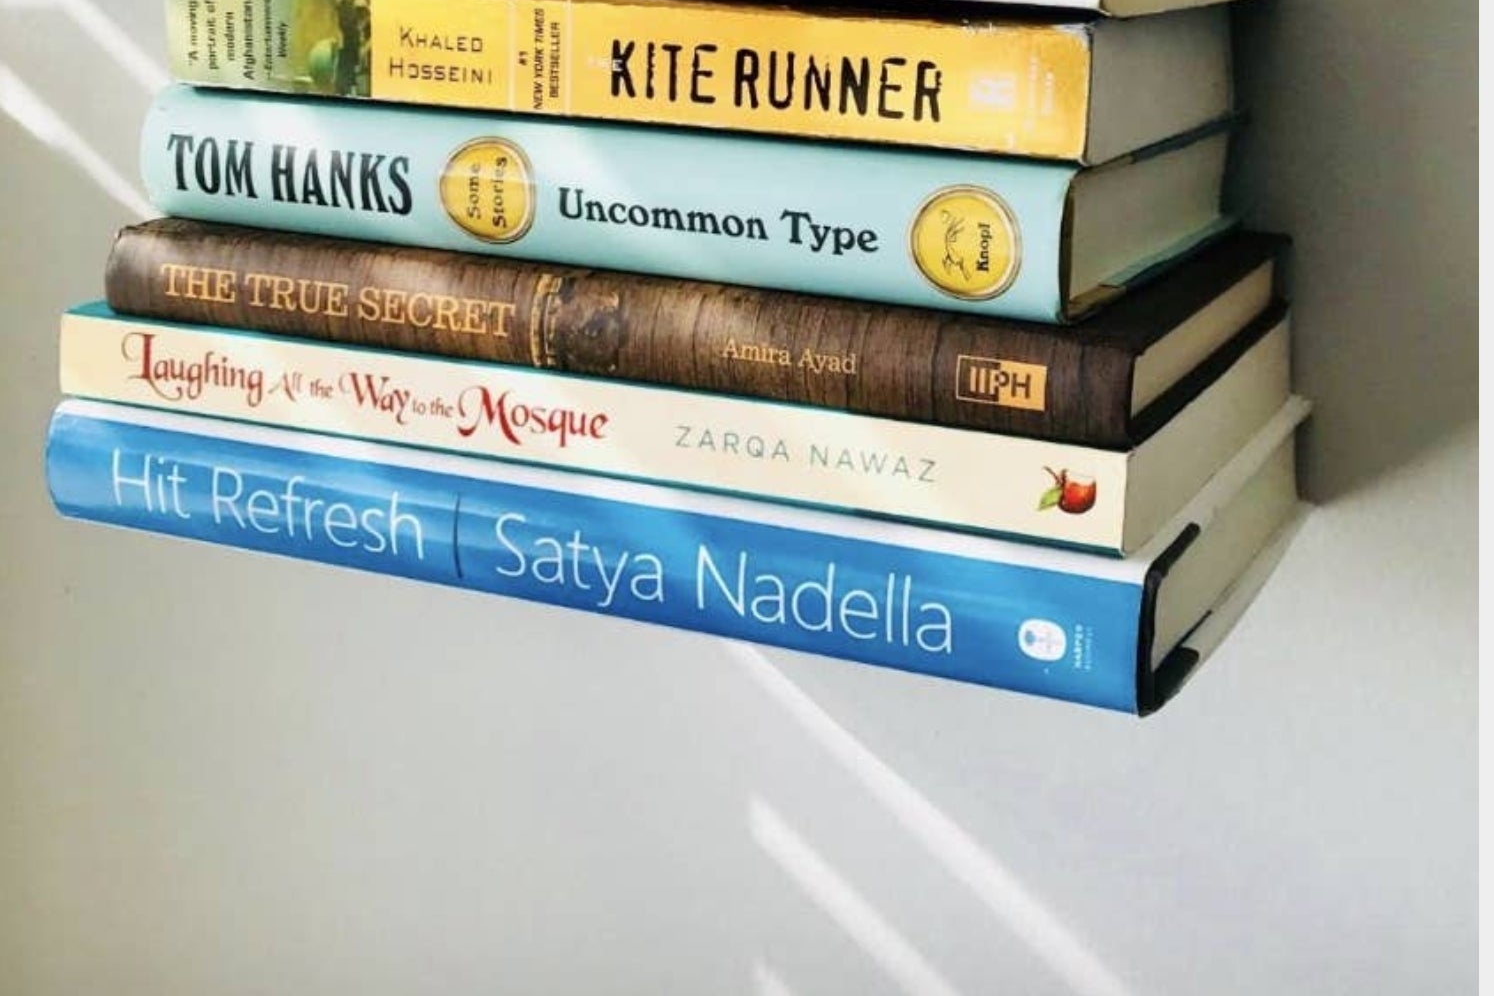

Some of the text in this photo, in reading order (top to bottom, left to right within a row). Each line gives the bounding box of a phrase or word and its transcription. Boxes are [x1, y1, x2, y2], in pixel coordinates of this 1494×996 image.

[187, 0, 200, 47] moving
[204, 0, 219, 71] portrait of
[224, 11, 236, 61] modern
[399, 26, 484, 54] KHALED
[389, 61, 493, 85] HOSSEINI
[533, 8, 545, 110] NEW YORK TIMES
[548, 21, 560, 98] BESTSELLER
[610, 39, 718, 104] KITE
[734, 48, 942, 122] RUNNER
[167, 133, 413, 216] TOM HANKS
[466, 162, 482, 220] Some
[491, 155, 508, 229] Stories
[558, 187, 879, 255] Uncommon Type
[975, 222, 991, 273] Knopf
[160, 263, 516, 337] THE TRUE SECRET
[121, 331, 611, 448] Laughing All the Way to the Mosque
[721, 337, 857, 375] Amira Ayad
[675, 425, 937, 483] ZARQA NAWAZ
[112, 448, 953, 654] Hit Refresh Satya Nadella
